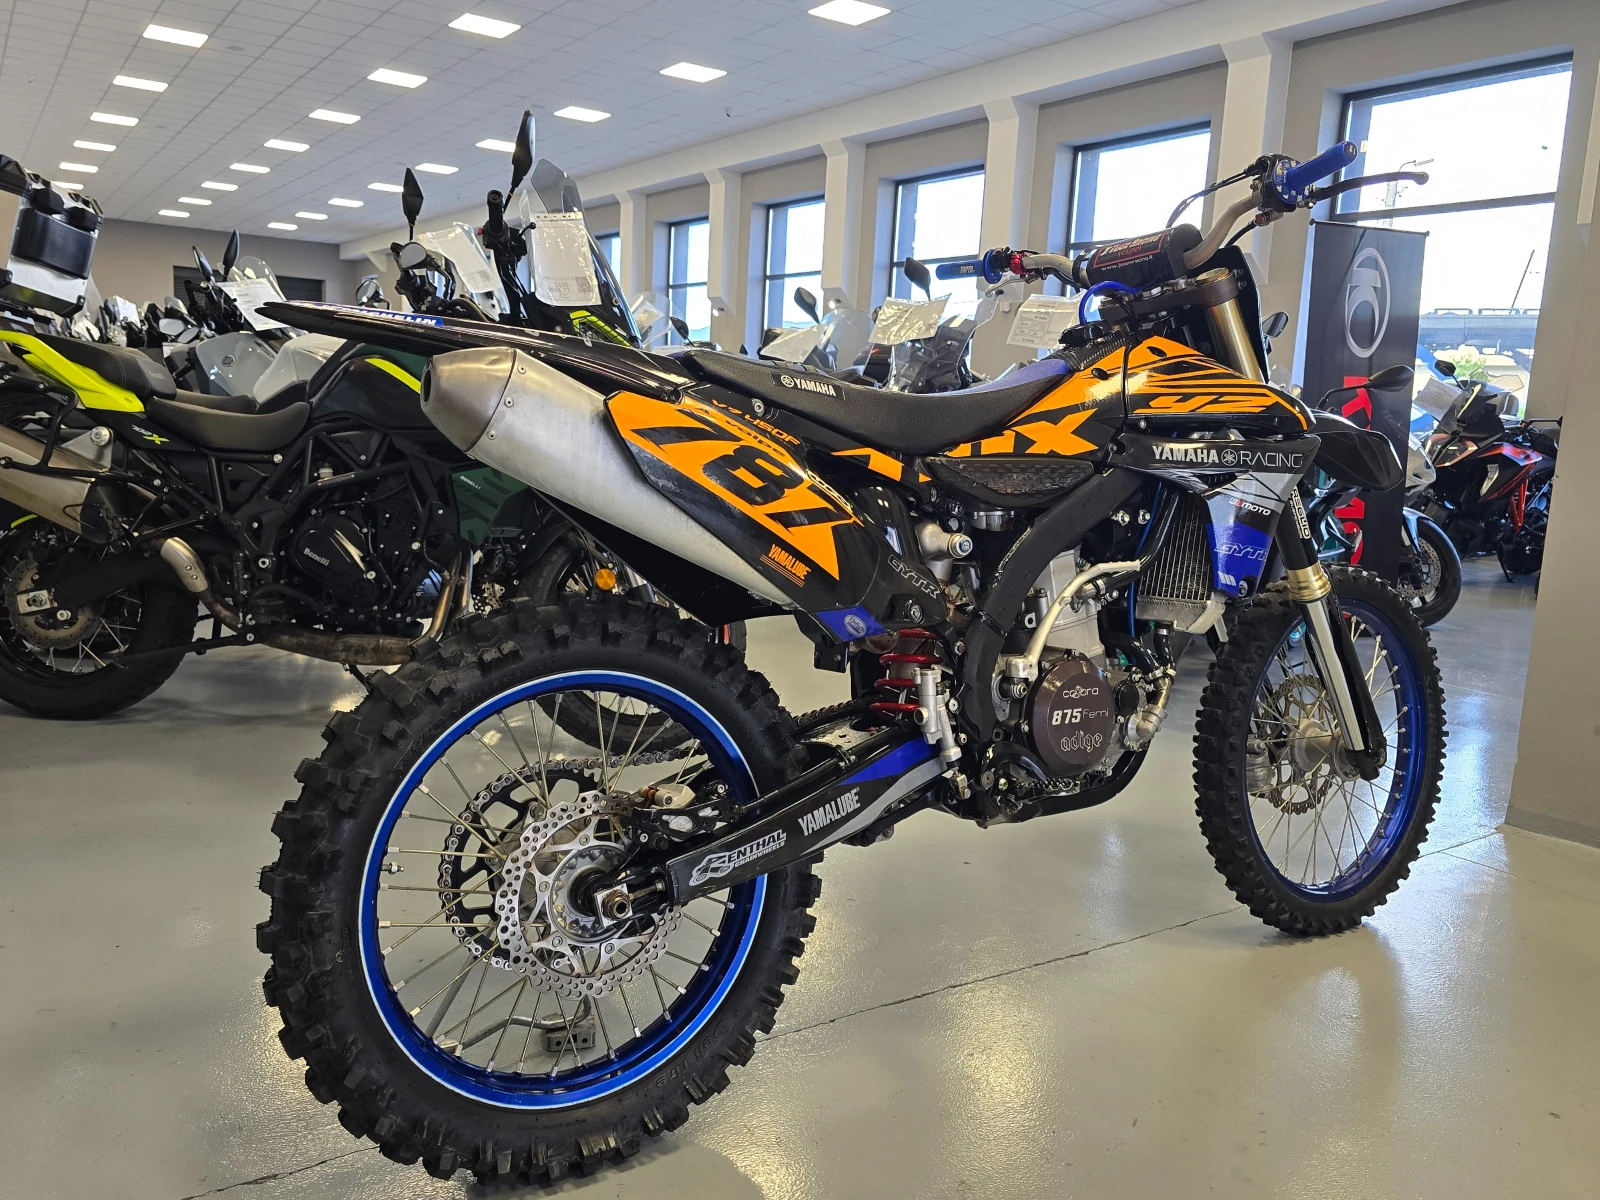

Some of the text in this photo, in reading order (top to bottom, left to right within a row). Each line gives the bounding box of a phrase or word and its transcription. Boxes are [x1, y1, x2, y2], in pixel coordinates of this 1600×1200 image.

[793, 377, 837, 397] YAMAHA
[1132, 395, 1279, 414] YZ
[1152, 445, 1303, 468] YAMAHA RACING
[631, 408, 854, 531] 787
[303, 547, 330, 567] Benelli
[768, 543, 811, 580] YAMALUBE
[888, 555, 940, 599] GYTR
[1051, 707, 1082, 726] 875
[1061, 730, 1103, 753] adige
[798, 787, 861, 837] YAMALUBE
[734, 840, 786, 868] CHAINWHEELS
